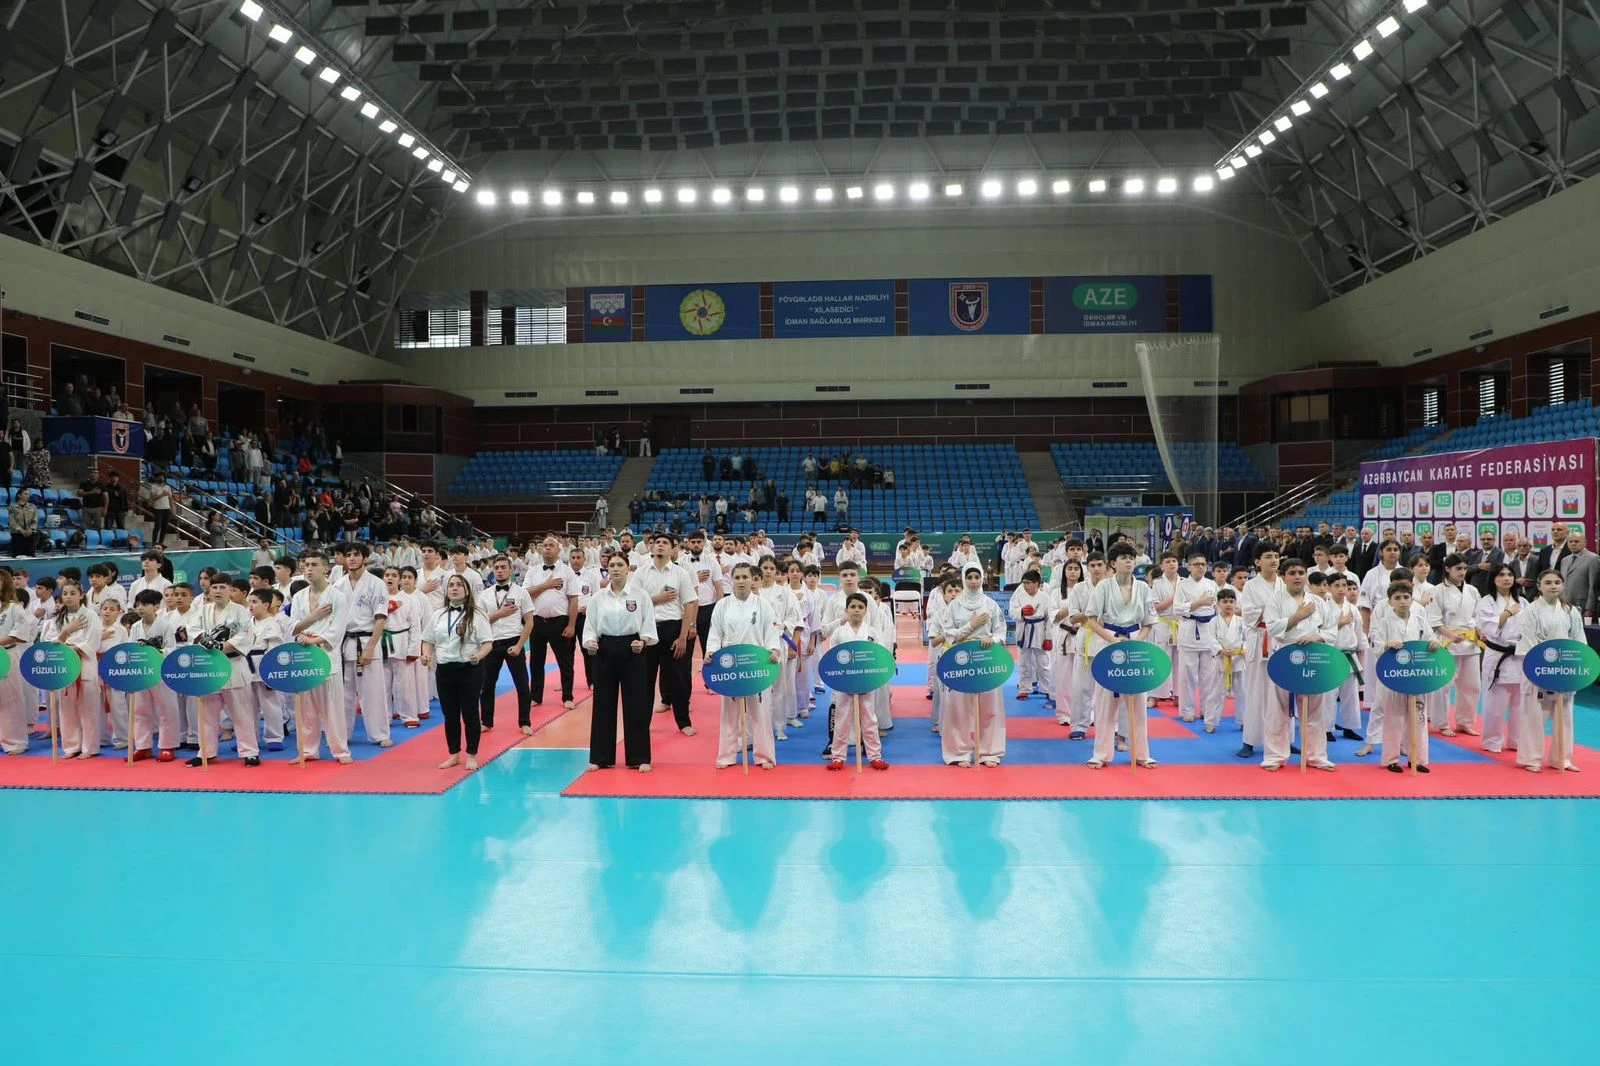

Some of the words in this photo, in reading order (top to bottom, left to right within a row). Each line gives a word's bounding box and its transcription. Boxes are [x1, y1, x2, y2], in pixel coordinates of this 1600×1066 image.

[824, 294, 854, 302] HALLAR
[1083, 288, 1127, 305] AZE
[785, 317, 808, 325] İDMAN
[1363, 469, 1423, 485] AZƏRBAYCAN
[1430, 465, 1472, 481] KARATE
[1480, 453, 1584, 477] FEDERASİYASI
[1438, 495, 1449, 506] AZE
[1505, 493, 1520, 504] AZE
[31, 665, 57, 674] FÜZULİ
[109, 668, 142, 676] RAMANA
[267, 670, 289, 680] ATEF
[290, 668, 325, 678] KARATE
[711, 673, 737, 682] BUDO
[738, 669, 770, 679] KLUBU
[943, 668, 976, 679] KEMPO
[977, 665, 1008, 675] KLUBU
[1107, 667, 1141, 678] KÖLGƏ
[1142, 666, 1155, 677] İ.K
[1384, 668, 1433, 678] LOKBATAN
[1435, 666, 1447, 677] İ.K
[1534, 665, 1576, 677] ÇEMPİON
